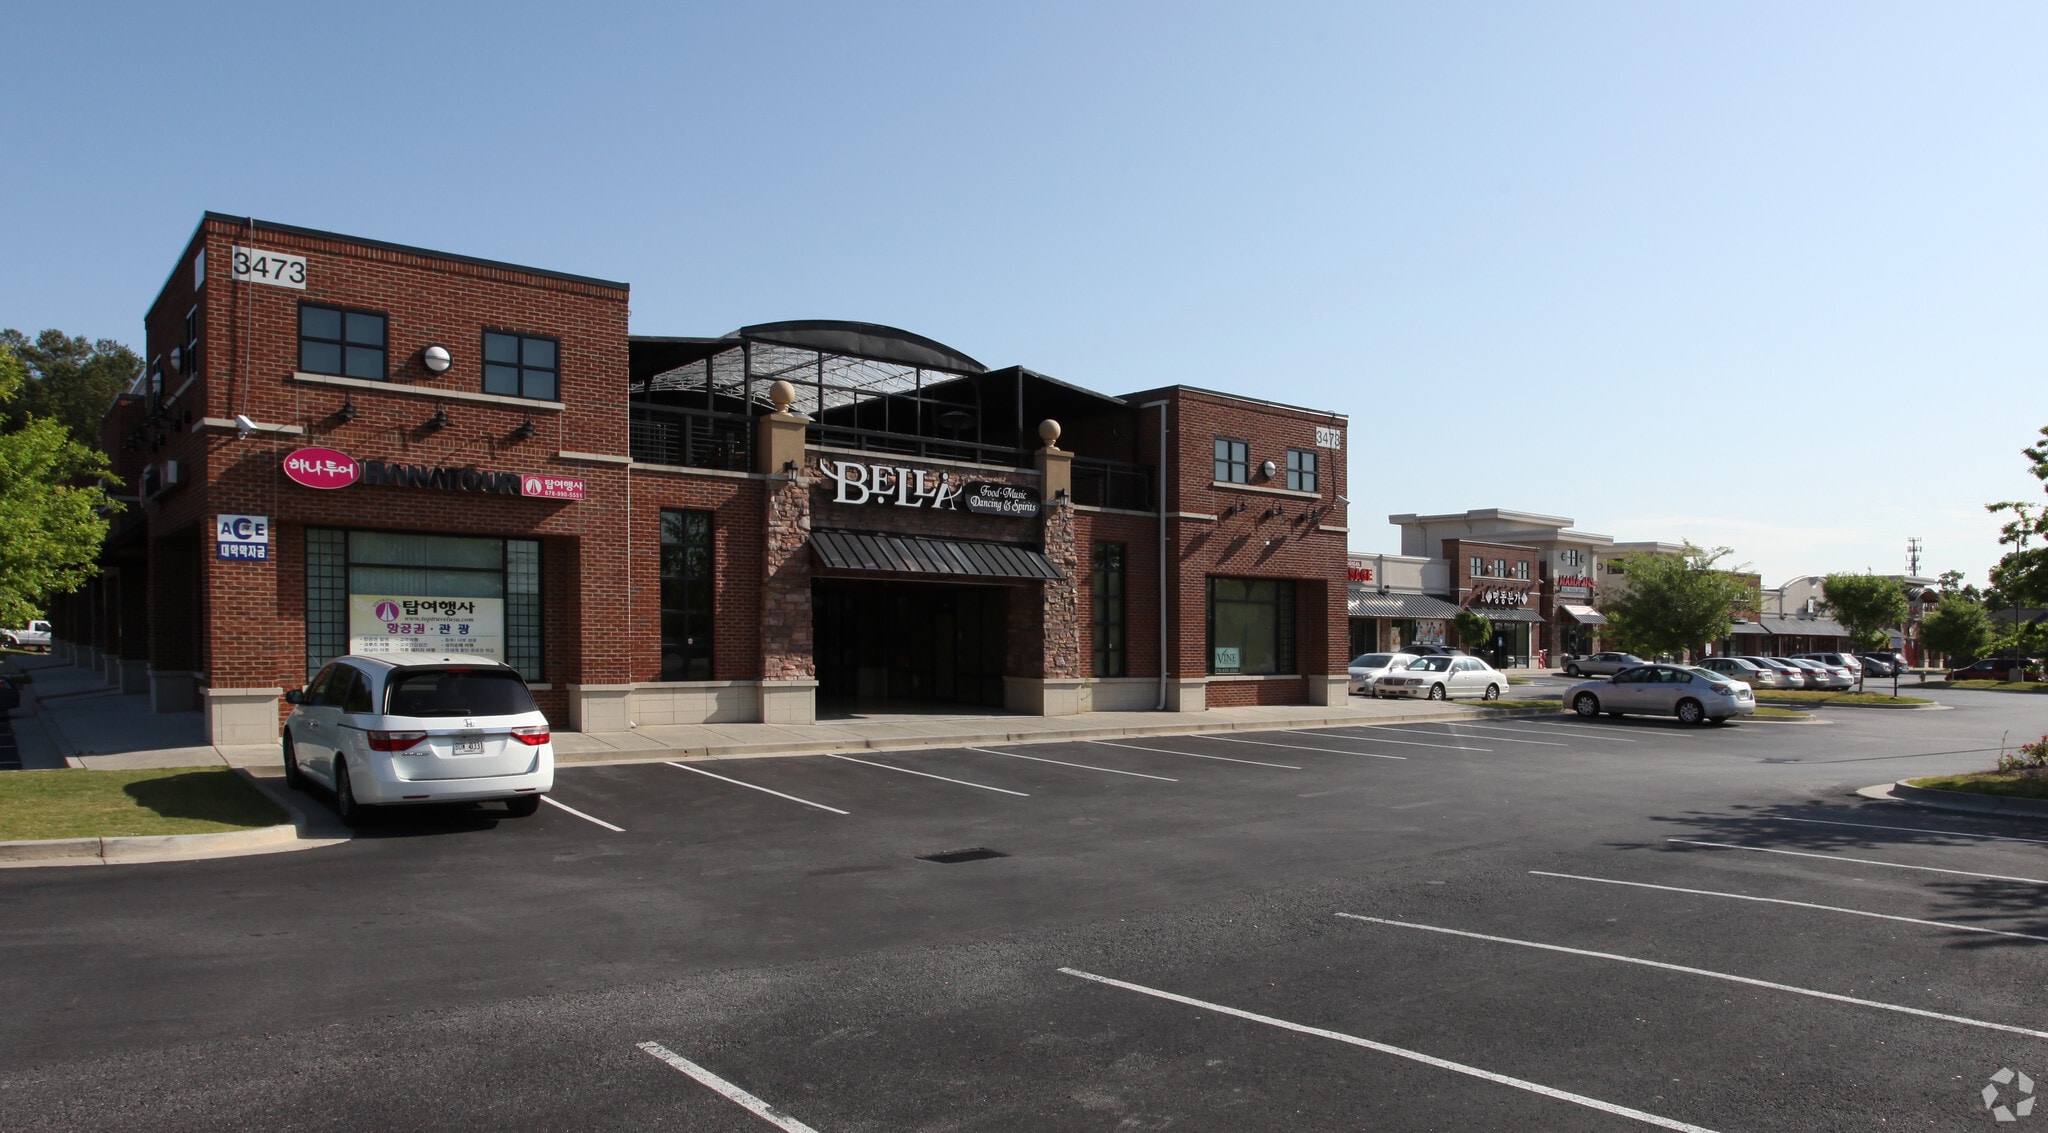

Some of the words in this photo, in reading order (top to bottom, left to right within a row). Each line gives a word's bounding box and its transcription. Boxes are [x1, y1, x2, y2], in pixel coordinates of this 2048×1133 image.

[233, 252, 306, 284] 3473
[1316, 430, 1341, 447] 3473
[288, 458, 354, 480] 하나투어
[364, 460, 519, 496] HANATOUR
[544, 479, 584, 492] 탑여행사
[970, 495, 1003, 512] Dancing
[1011, 498, 1037, 514] Spirits
[220, 517, 265, 540] ACE
[402, 600, 476, 616] 탑여행사
[386, 622, 425, 634] 항공권
[1217, 653, 1237, 664] VINE
